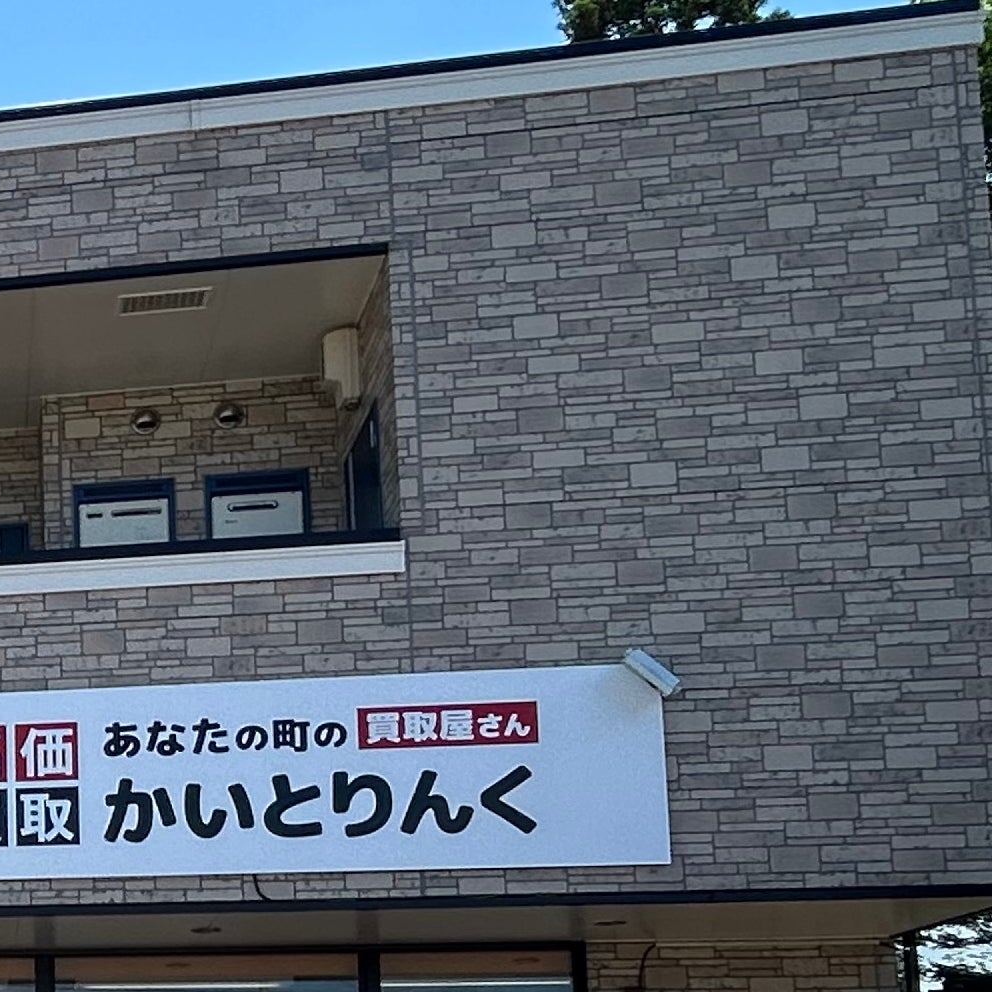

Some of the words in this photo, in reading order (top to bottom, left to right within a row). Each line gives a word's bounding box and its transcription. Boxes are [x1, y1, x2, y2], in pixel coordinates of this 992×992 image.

[104, 718, 348, 757] あなたの町の
[365, 710, 531, 744] 買取屋さん
[104, 765, 538, 843] かいとりんく
